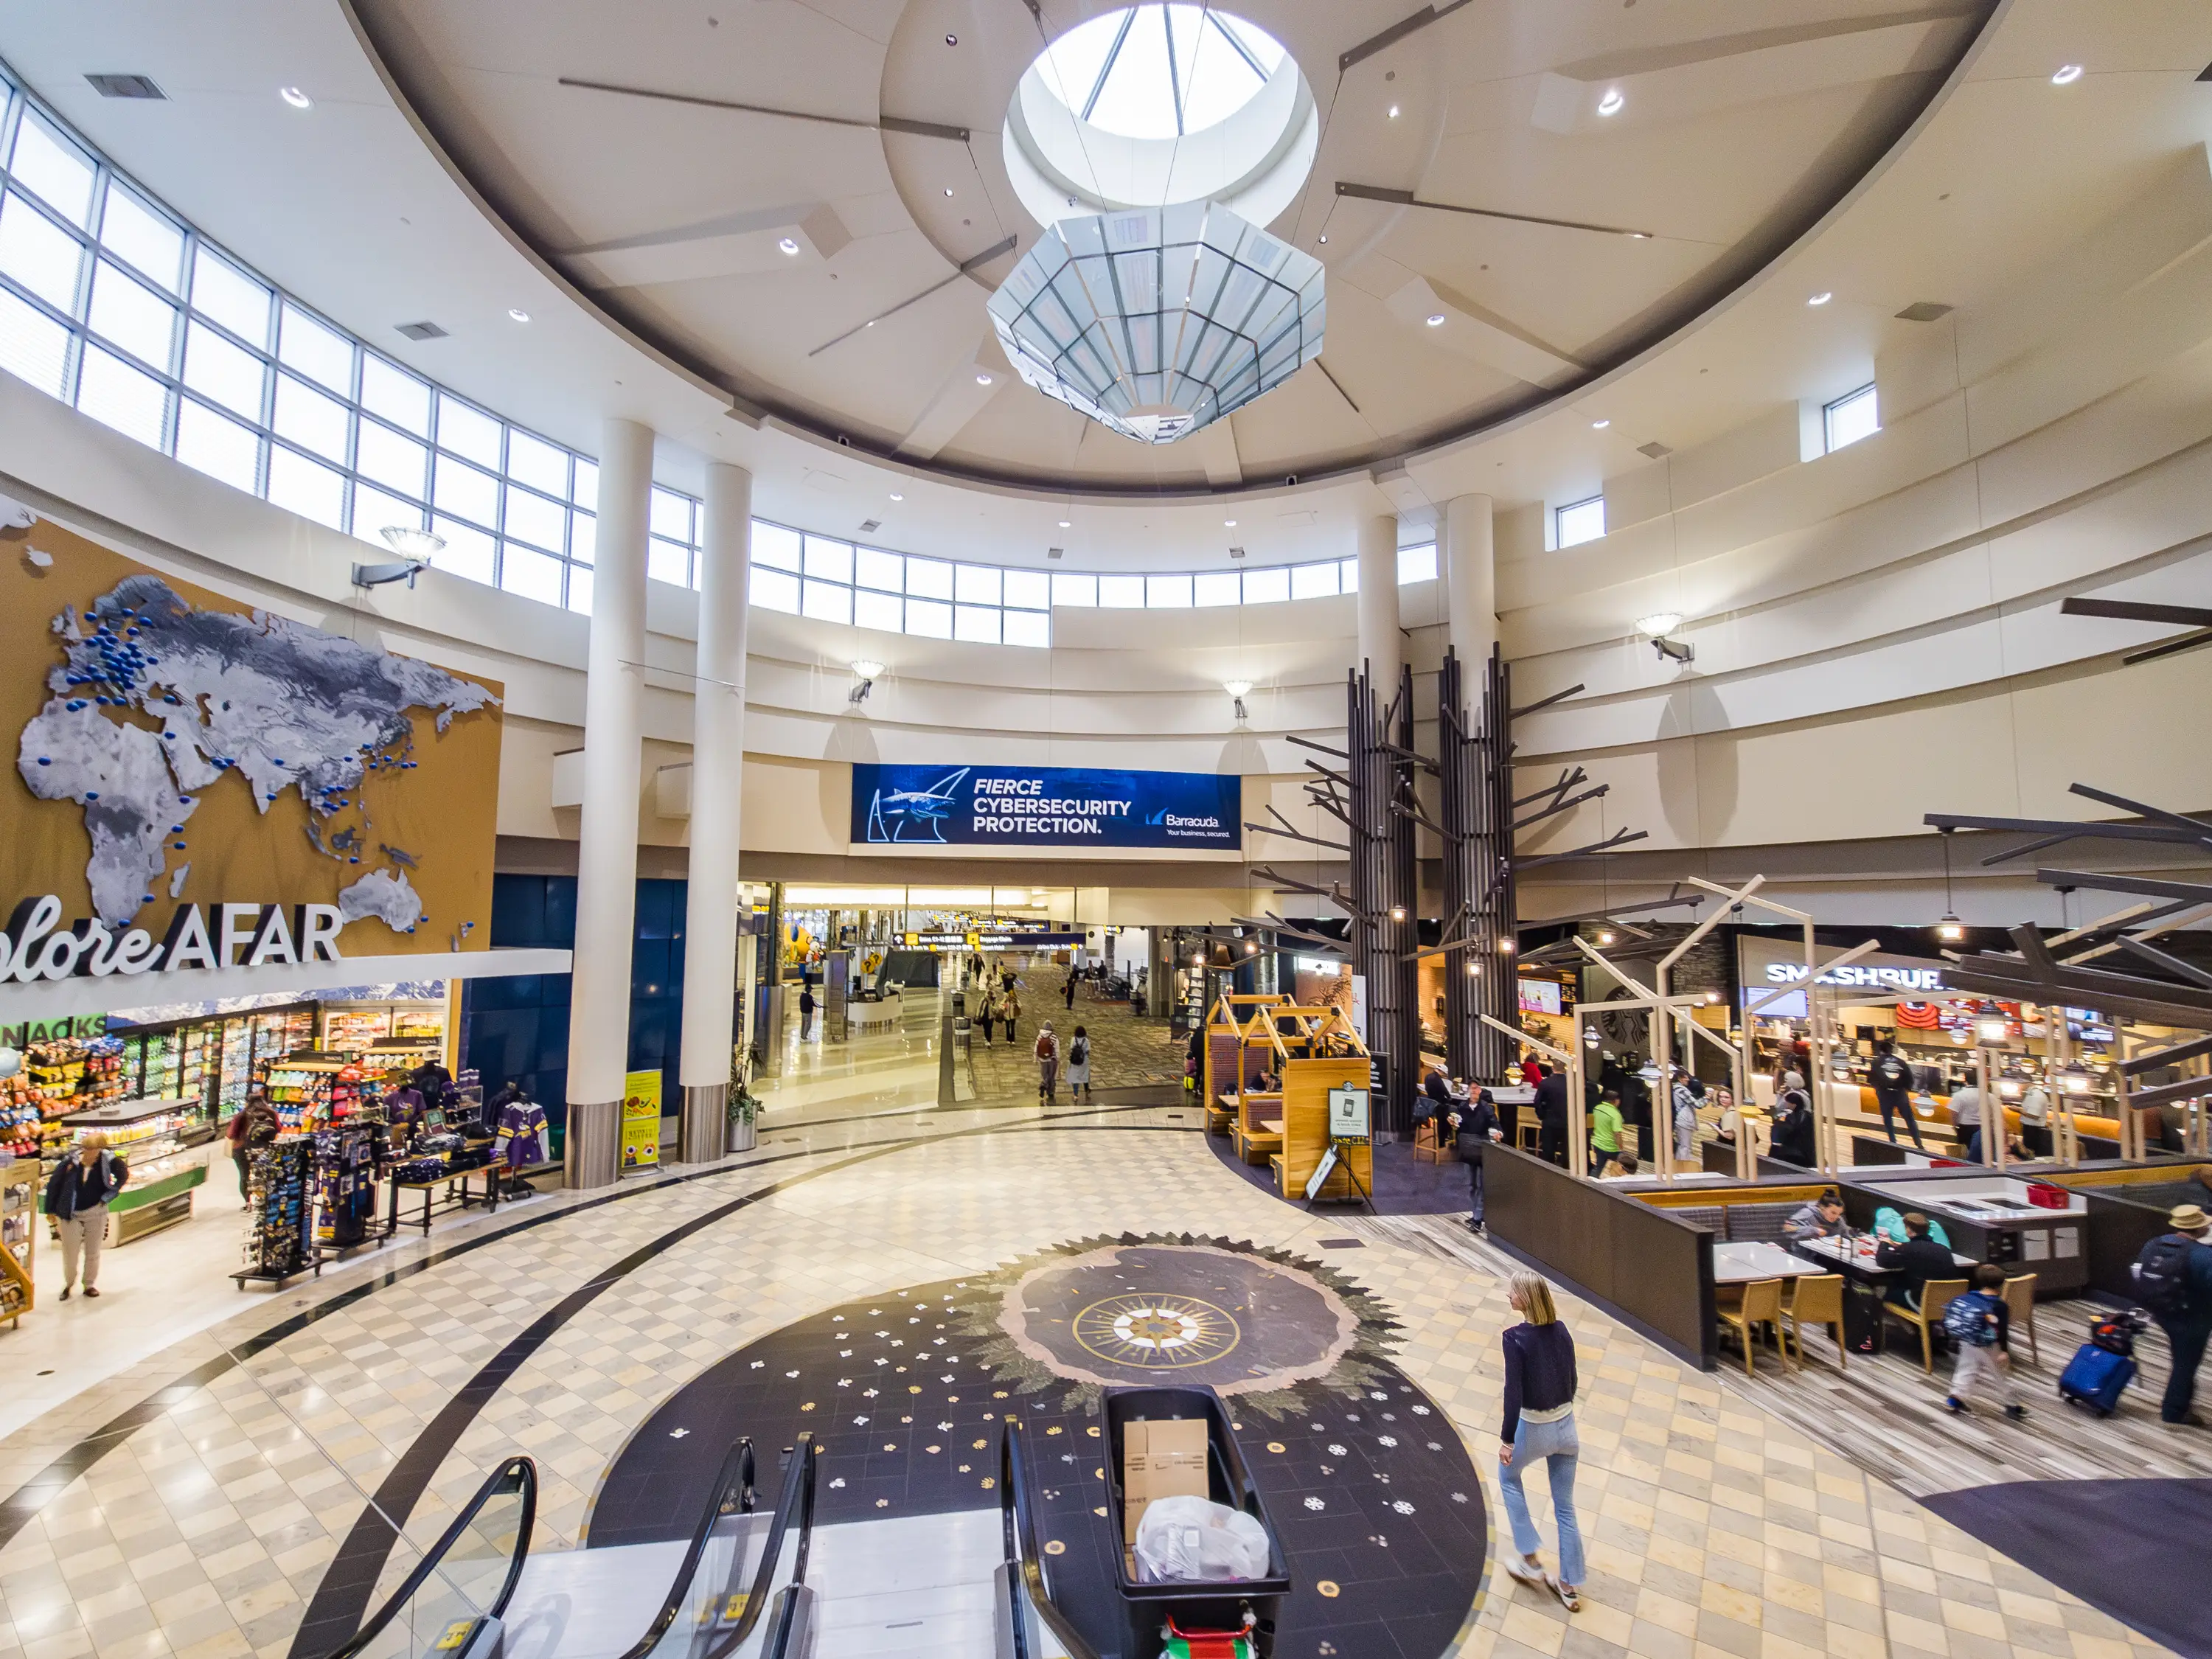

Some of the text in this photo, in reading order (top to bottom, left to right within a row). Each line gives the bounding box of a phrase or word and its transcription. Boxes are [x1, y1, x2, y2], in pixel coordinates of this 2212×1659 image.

[973, 779, 1043, 795] FIERCE
[973, 797, 1132, 816] CYBERSECURITY
[973, 815, 1102, 834] PROTECTION.
[1180, 830, 1207, 838] business,
[163, 901, 344, 972] AFAR
